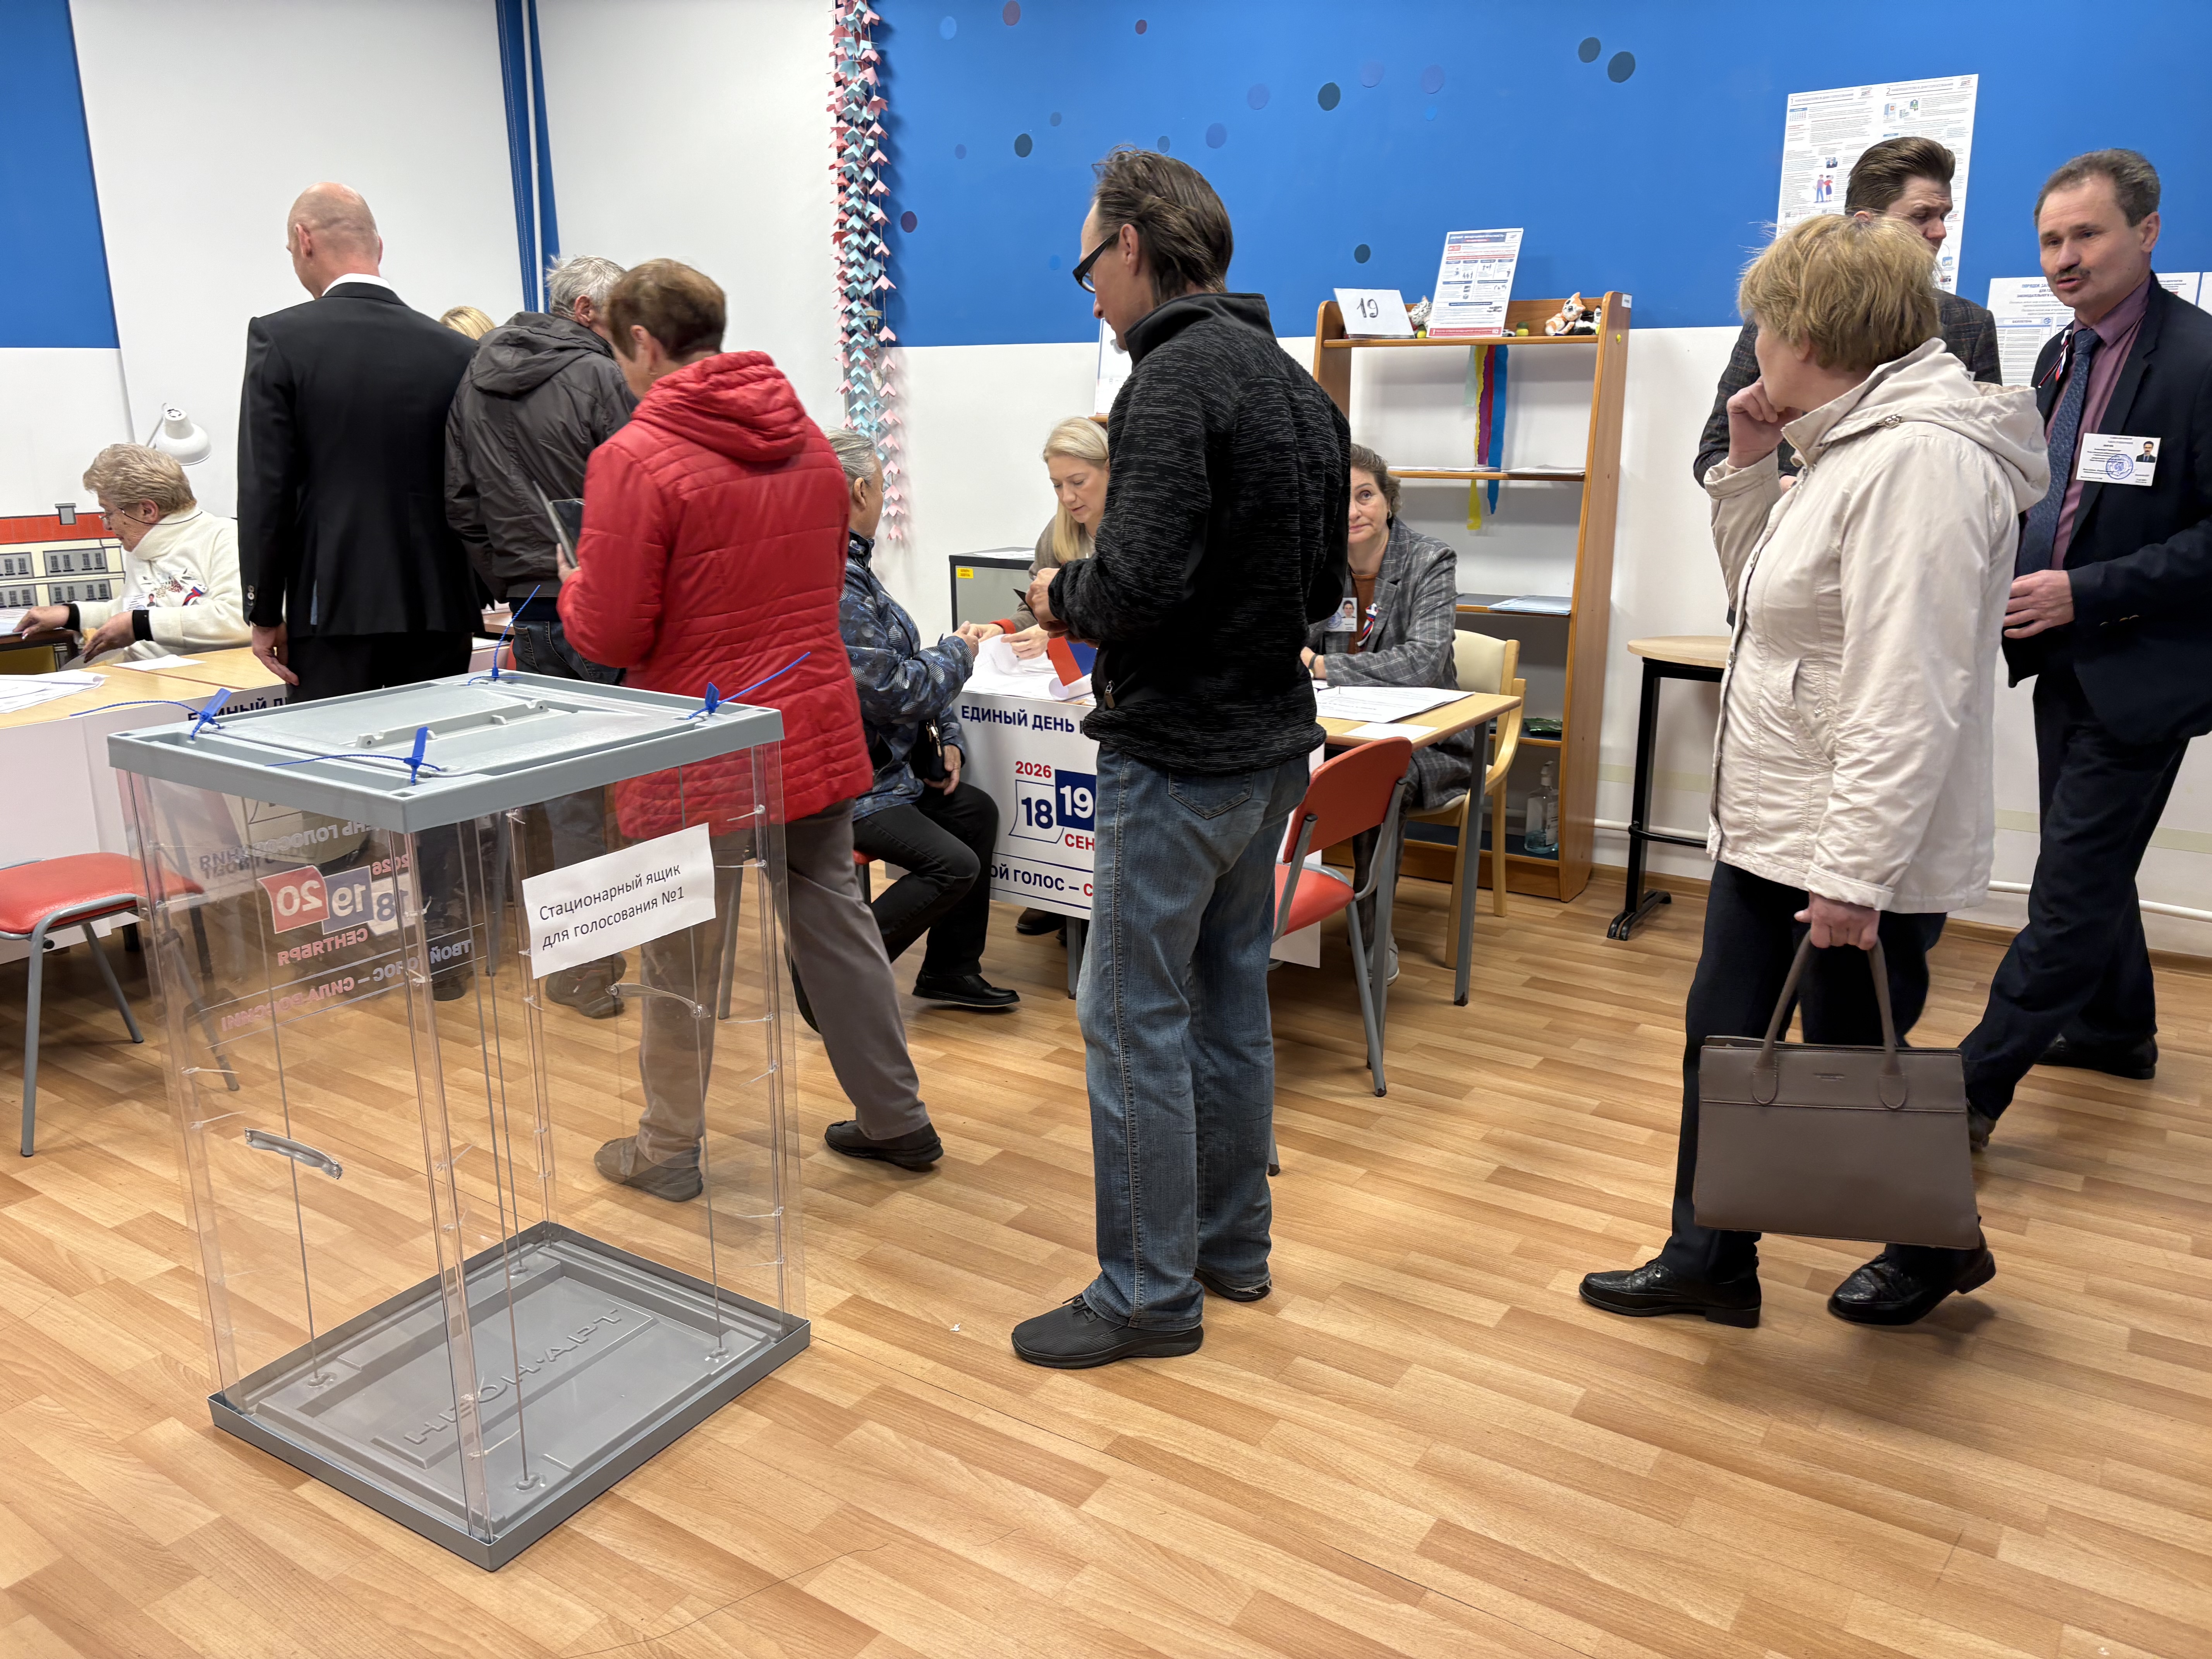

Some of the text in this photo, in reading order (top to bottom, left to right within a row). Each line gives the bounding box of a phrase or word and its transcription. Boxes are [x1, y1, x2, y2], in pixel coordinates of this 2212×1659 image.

[1357, 297, 1379, 318] 19
[187, 697, 267, 721] ЕИНЫЙ
[961, 706, 1028, 727] ЕДИНЫЙ
[1032, 714, 1075, 733] ДЕНЬ
[1015, 761, 1052, 779] 2026
[1021, 797, 1054, 829] 18
[1060, 785, 1094, 819] 19
[539, 864, 681, 921] Стационарный ящик
[1013, 869, 1065, 891] ГОЛОС
[542, 886, 685, 950] для голосования №1
